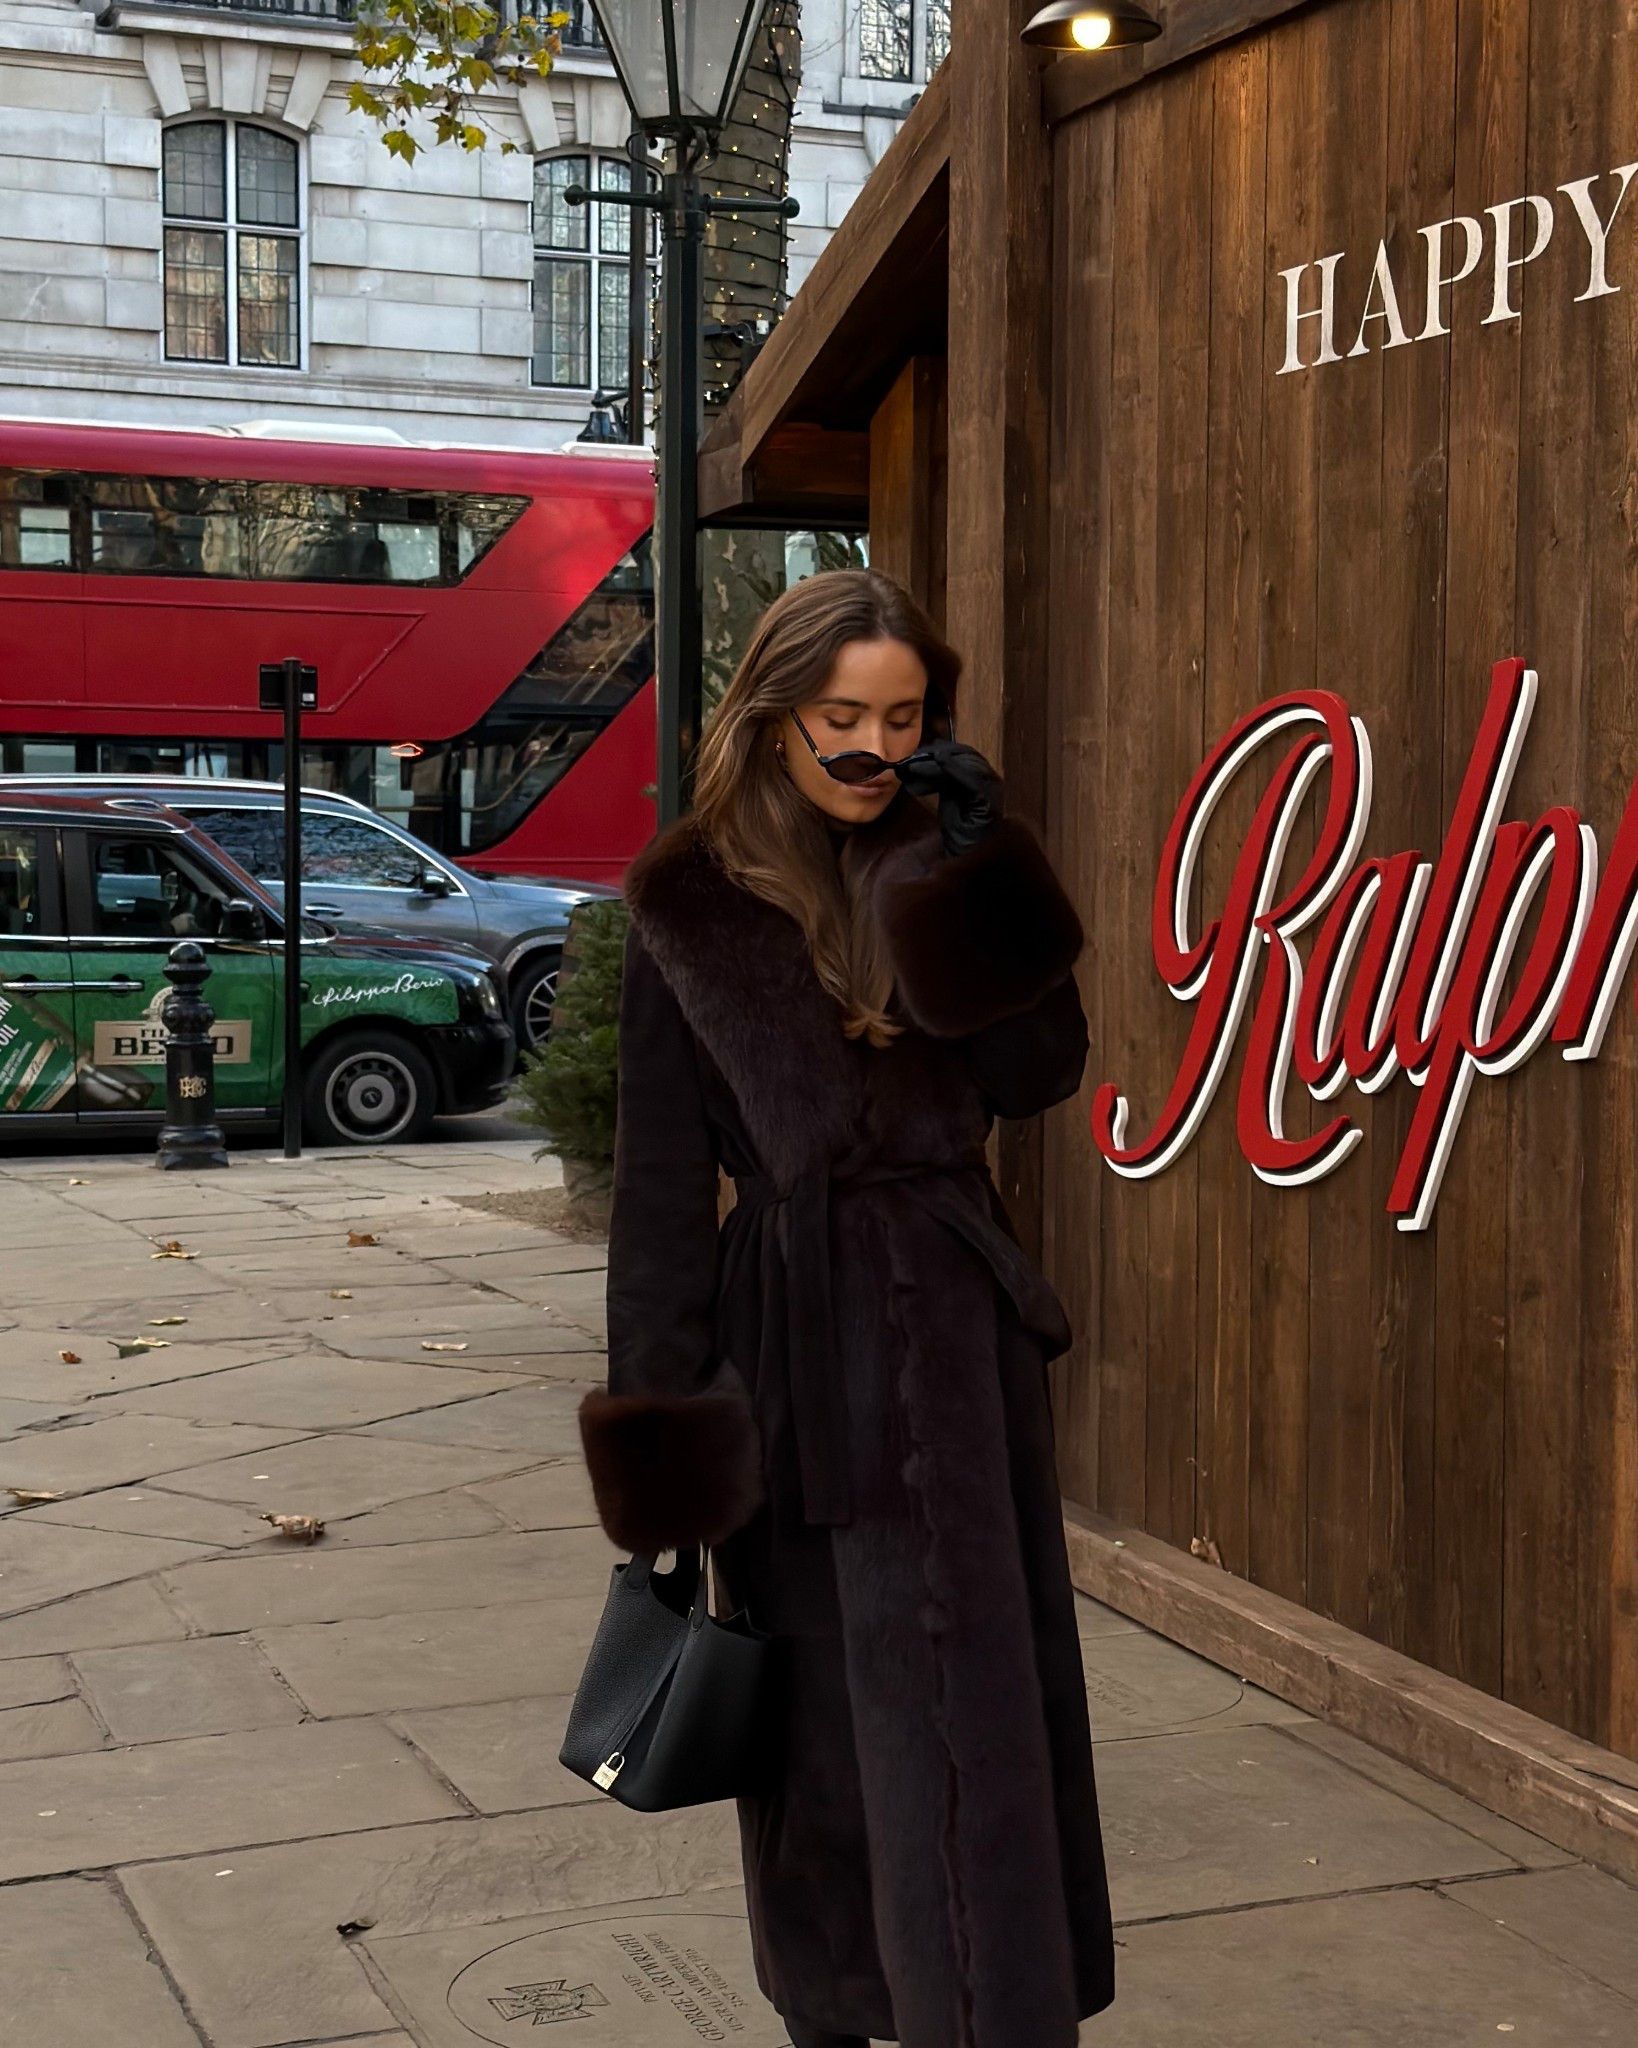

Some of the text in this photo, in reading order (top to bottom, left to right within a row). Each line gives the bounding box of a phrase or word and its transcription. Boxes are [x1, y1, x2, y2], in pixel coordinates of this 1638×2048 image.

[1275, 162, 1638, 376] HAPPY
[394, 973, 444, 994] Berio
[611, 1933, 726, 2041] GEORGE CARTWRIGHT
[622, 1973, 660, 2003] PRIVATE
[643, 1932, 746, 2032] AUSTRALIAN IMPERIAL FORCE
